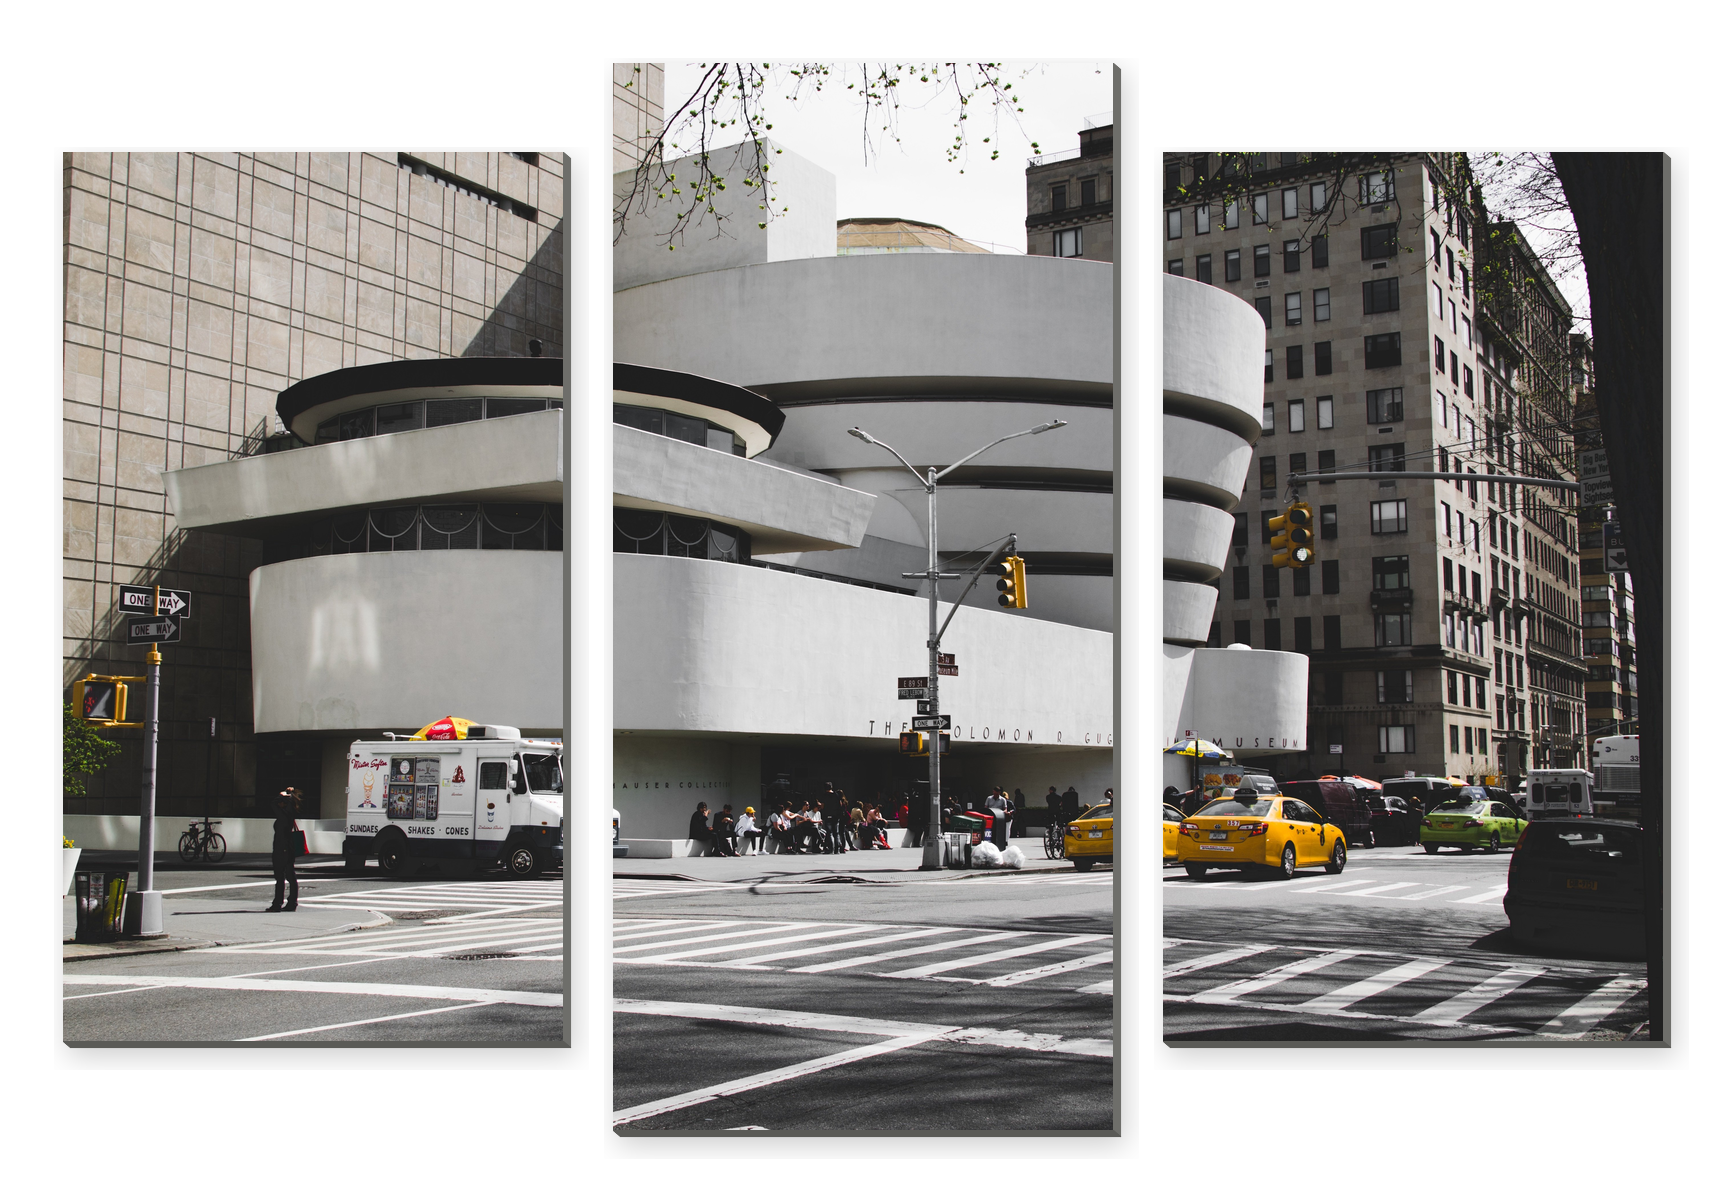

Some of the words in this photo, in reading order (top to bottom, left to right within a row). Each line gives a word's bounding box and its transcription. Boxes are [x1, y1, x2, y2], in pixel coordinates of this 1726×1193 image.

[1583, 455, 1593, 466] Big
[1595, 453, 1606, 463] Bus
[1583, 465, 1597, 476] New
[1598, 463, 1609, 473] Yor
[1583, 491, 1615, 504] Sightsee
[1611, 538, 1624, 546] BU
[129, 594, 150, 606] ONE
[159, 597, 180, 609] WAY
[135, 624, 150, 636] ONE
[156, 623, 173, 635] WAY
[954, 725, 1033, 741] OLOMON
[1212, 737, 1298, 748] MUSEUM
[351, 759, 369, 769] Mister
[349, 824, 379, 834] SUNDAES
[407, 826, 435, 835] SHAKES
[445, 826, 470, 836] CONES
